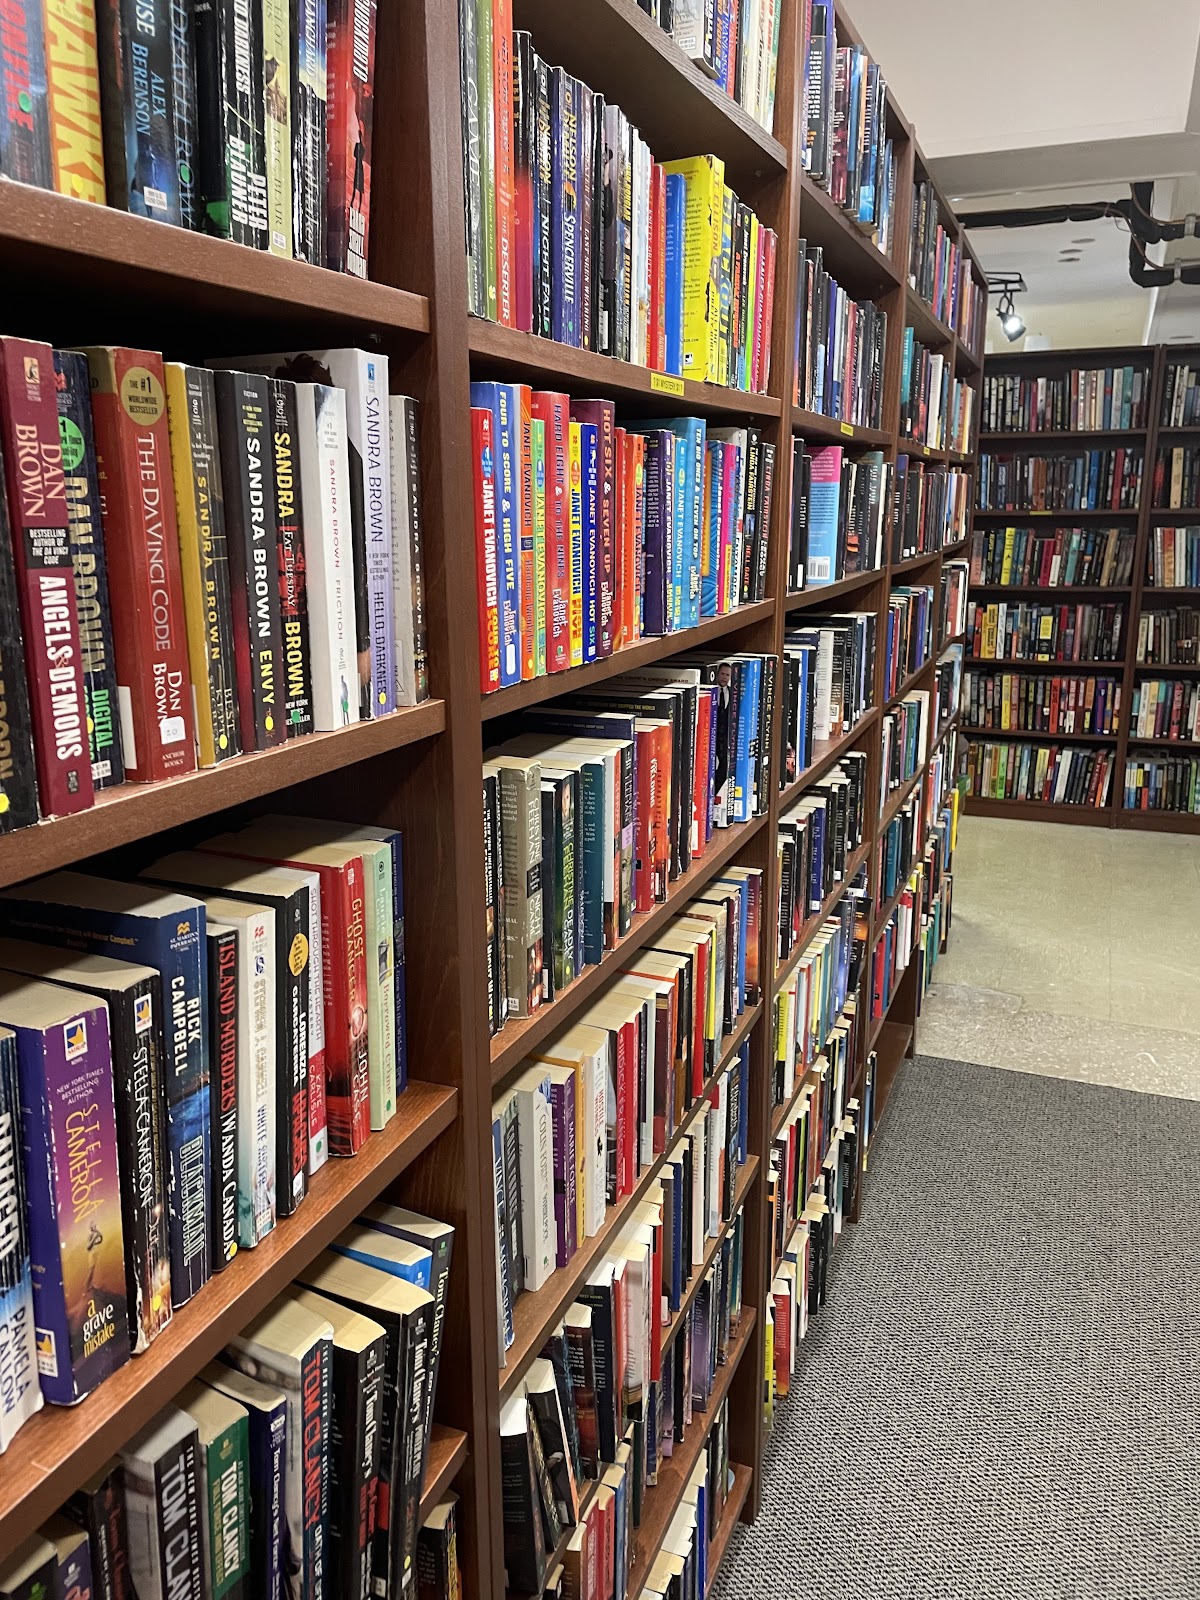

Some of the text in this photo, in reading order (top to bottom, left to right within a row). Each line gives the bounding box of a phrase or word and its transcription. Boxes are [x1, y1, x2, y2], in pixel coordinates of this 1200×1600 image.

[131, 41, 152, 135] BERENSON
[170, 4, 193, 125] DEATH
[234, 17, 251, 95] DARKNESS
[150, 70, 167, 119] ALEX
[229, 134, 249, 224] BLAUNER
[246, 170, 267, 231] PETER
[541, 213, 551, 277] NIGHT
[712, 195, 720, 252] ELLISON
[501, 236, 510, 320] DESERTER
[563, 212, 577, 304] SPENCERVILLE
[718, 191, 733, 342] BLACKOUT
[128, 394, 158, 405] WORLDWIDE
[129, 406, 158, 416] BESTSELLER
[140, 376, 153, 394] #1
[365, 395, 381, 470] SANDRA
[749, 446, 757, 471] LINDA
[15, 423, 46, 518] BROWN
[40, 442, 66, 500] DAN
[274, 432, 295, 519] SANDRA
[500, 391, 515, 591] FOUR TO SCORE & HIGH FIVE
[523, 422, 532, 527] JANET EVANOVICH
[554, 404, 565, 578] HARD EIGHT & TO THE NINES
[602, 409, 613, 574] HOT SIX & SEVEN UP
[746, 471, 756, 511] FAIRSTEIN
[29, 528, 67, 540] BESTSELLING
[65, 476, 95, 544] DAN
[137, 432, 171, 652] THE CODE
[197, 476, 214, 569] SANDRA
[369, 476, 384, 542] BROWN
[482, 479, 497, 607] JANET EVANOVICH
[571, 488, 581, 595] JANET EVANOVICH
[665, 478, 673, 574] JANET EVANOVICH
[675, 488, 685, 578] JANET EVANOVICH
[246, 437, 275, 705] SANDRA BROWN ENVY
[285, 554, 296, 607] TUESDAY
[329, 459, 343, 641] SANDRA BROWN FRICTION
[535, 492, 546, 630] JANET EVANOVICH
[588, 486, 597, 646] JANET EVANOVICH HOT SIX
[205, 580, 220, 660] BROWN
[502, 600, 513, 646] Evanovich
[507, 607, 517, 635] Janet
[552, 588, 563, 638] Evanovich
[558, 599, 569, 627] Janet
[600, 581, 609, 627] Evanovich
[605, 591, 613, 618] Janet
[39, 575, 83, 761] ANGELS DEMONS
[284, 621, 304, 697] BROWN
[487, 608, 495, 670] SCORE
[91, 688, 114, 752] DIGITAL
[152, 662, 169, 728] BROWN
[167, 671, 183, 712] DAN
[223, 687, 235, 732] BEST
[731, 682, 739, 720] VINCE
[764, 675, 774, 750] VINCE FLYNN
[528, 799, 536, 865] FEEHAN
[533, 797, 541, 864] CHRISTINE
[567, 842, 575, 908] CHRISTINE
[351, 898, 366, 958] GHOST
[346, 925, 356, 1003] DANCER
[171, 976, 189, 1078] CAMPBELL
[187, 996, 201, 1045] RICK
[292, 985, 300, 1088] CARCATERRA
[299, 1011, 308, 1080] LORENZO
[383, 982, 392, 1050] Borrowed
[56, 1067, 105, 1093] NEW YORK TIMES
[60, 1076, 100, 1101] BESTSELLING
[67, 1089, 95, 1106] AUTHOR
[218, 943, 236, 1256] ISLAND MURDERS WANDA CANADA
[308, 1064, 318, 1128] CARLISLE
[315, 1074, 323, 1107] KATE
[352, 1073, 362, 1124] CASE
[358, 1049, 369, 1104] JOHN
[617, 1055, 625, 1164] DICK FRANCIS
[83, 1103, 105, 1213] STELLA
[132, 1045, 154, 1209] STELLA CAMERON
[539, 1114, 548, 1153] COLIN
[567, 1120, 575, 1164] MARIE
[64, 1111, 93, 1224] CAMERON
[179, 1135, 205, 1267] BLACKMAIL
[506, 1125, 517, 1221] COLIN FORBES
[82, 1303, 115, 1343] grave
[83, 1321, 116, 1359] mistake
[87, 1299, 96, 1317] a
[429, 1267, 450, 1366] Tom Clancy's
[10, 1304, 32, 1397] PAMELA
[321, 1344, 329, 1362] THE
[409, 1338, 428, 1425] Tom Clancy's
[321, 1392, 329, 1418] YORK
[321, 1421, 329, 1452] TIMES
[364, 1391, 379, 1422] Tom
[272, 1447, 283, 1517] Tom Clancy's
[303, 1350, 323, 1560] TOM CLANCY OATH
[361, 1420, 378, 1480] Clancy's
[161, 1452, 189, 1533] TOM
[186, 1445, 199, 1565] THE NEW YORK TIMES
[220, 1460, 240, 1578] TOM CLANCY
[320, 1455, 329, 1516] BESTSELLER
